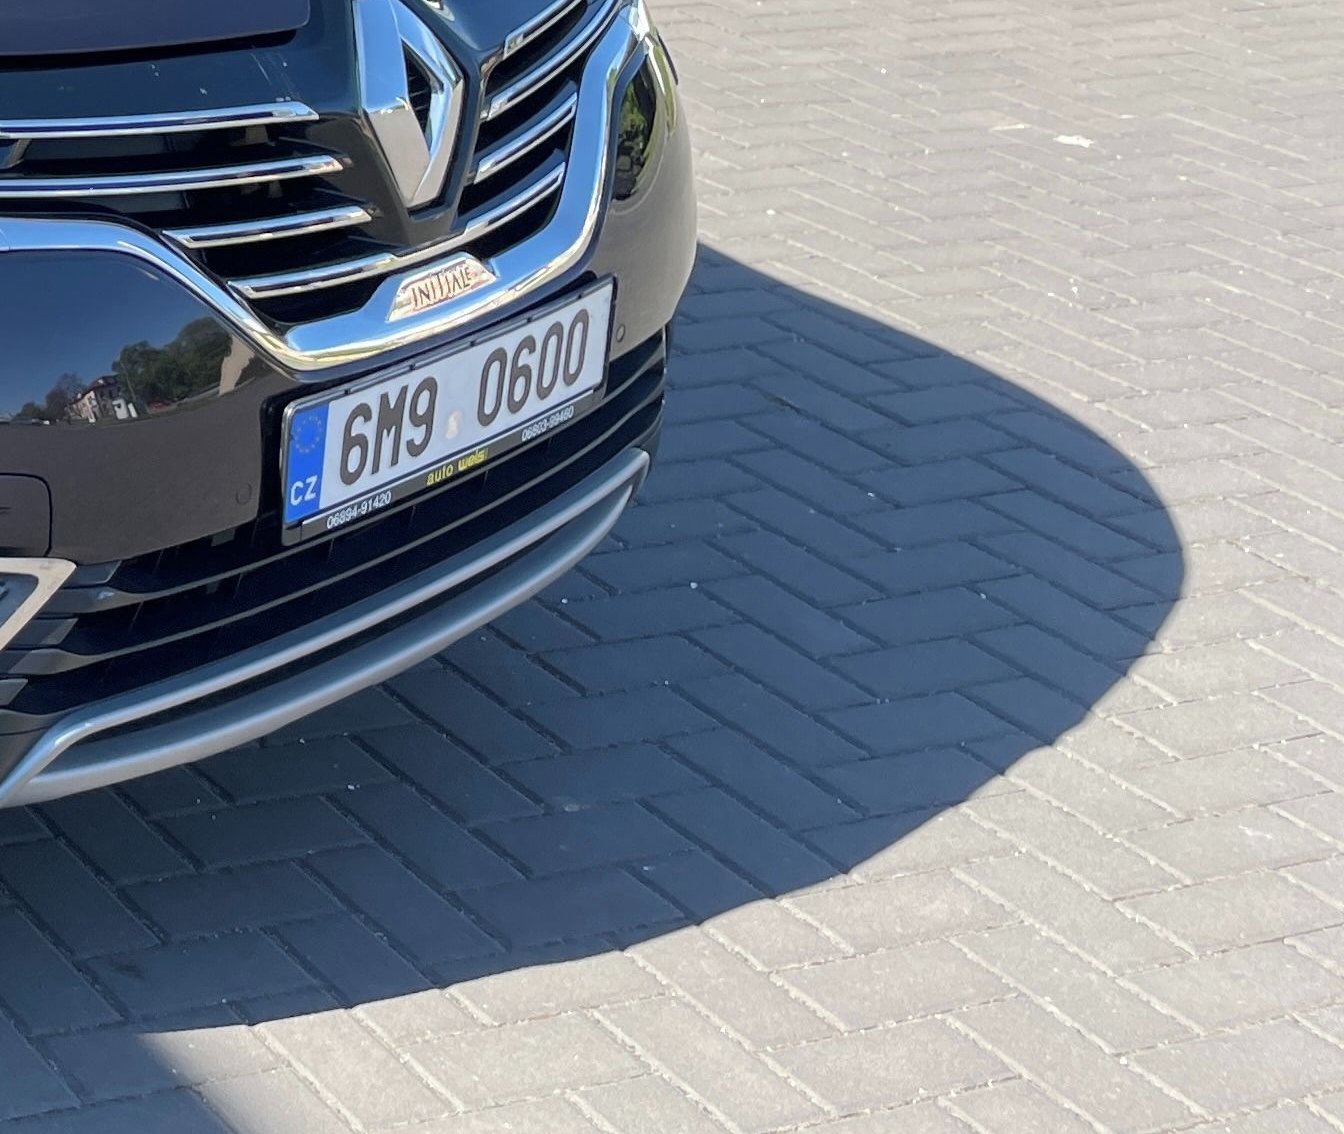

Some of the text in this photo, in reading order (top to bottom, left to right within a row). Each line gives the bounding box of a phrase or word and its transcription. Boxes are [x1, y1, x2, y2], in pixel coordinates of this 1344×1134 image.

[411, 266, 472, 307] INITIALE
[339, 308, 589, 486] 6M9 0600
[290, 475, 317, 506] CZ
[426, 464, 454, 486] auto
